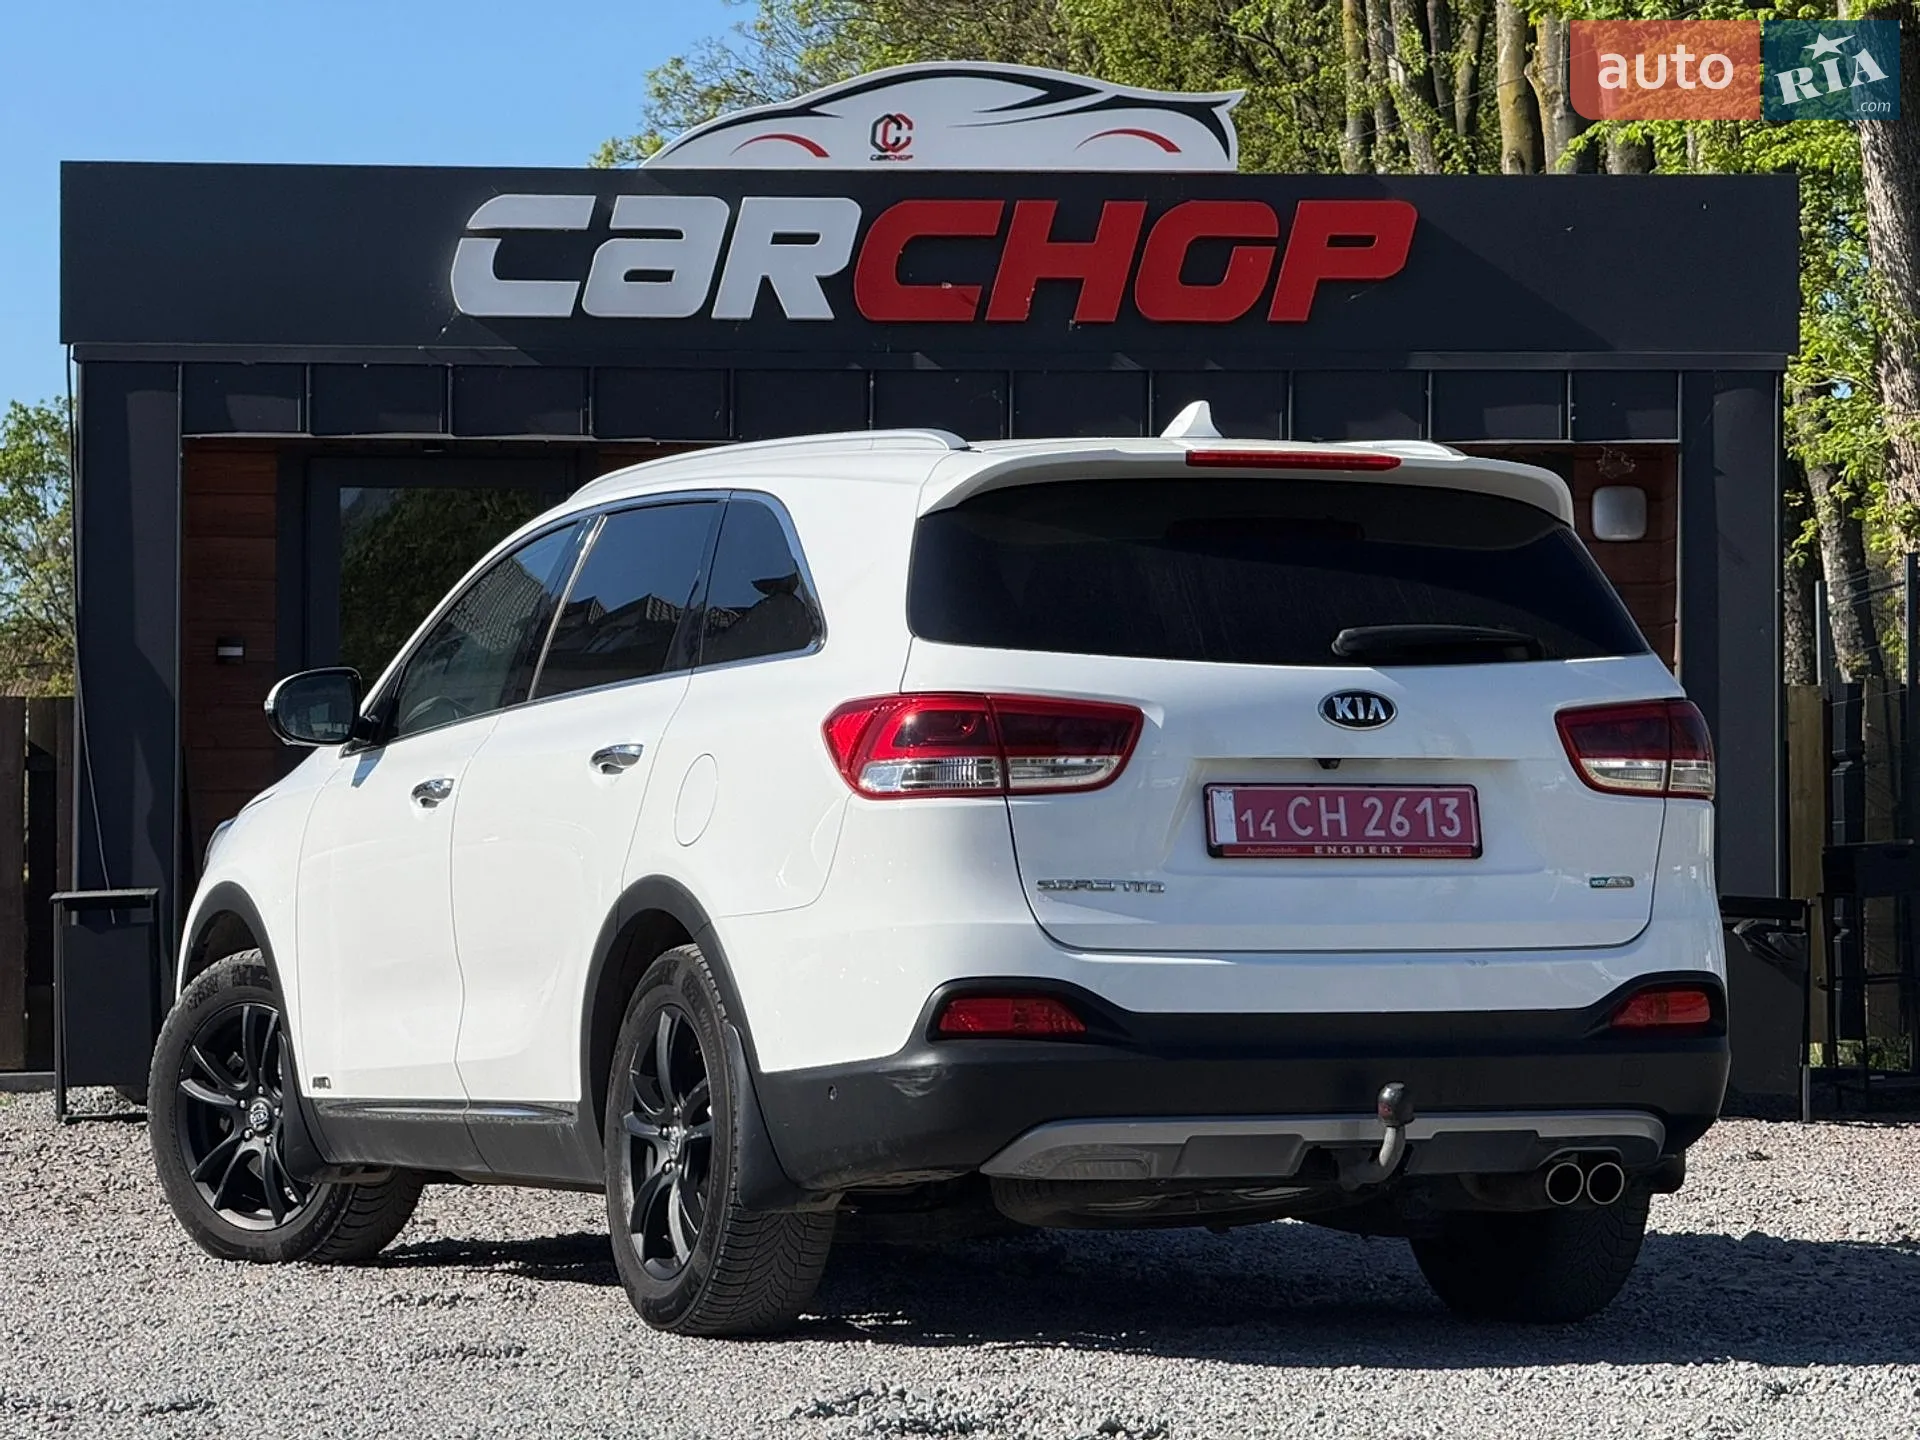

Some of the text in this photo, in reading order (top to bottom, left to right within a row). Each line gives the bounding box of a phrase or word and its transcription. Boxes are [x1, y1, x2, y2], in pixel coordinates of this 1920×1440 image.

[1333, 697, 1387, 720] KIA
[1240, 796, 1462, 838] 14 CH 2613
[1314, 846, 1403, 854] ENGBERT
